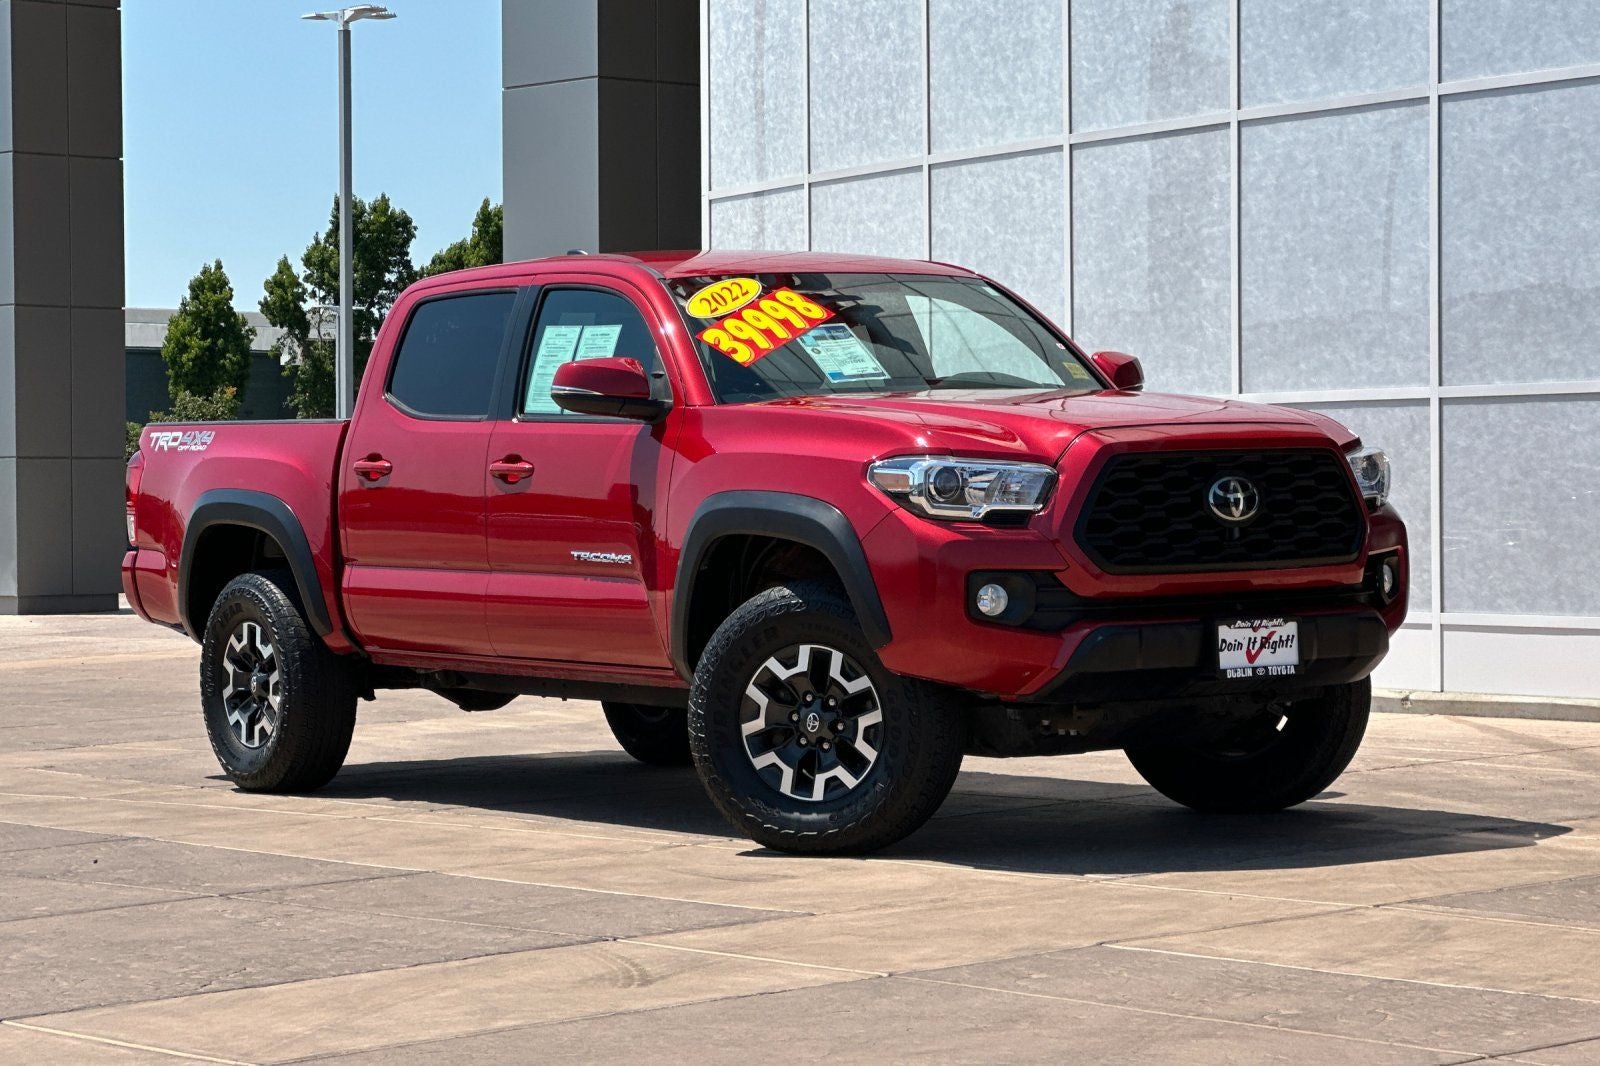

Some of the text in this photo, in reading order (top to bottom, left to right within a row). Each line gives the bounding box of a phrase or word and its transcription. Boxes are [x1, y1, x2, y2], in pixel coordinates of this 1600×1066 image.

[699, 281, 749, 315] 2022
[702, 290, 827, 363] 39998
[149, 431, 183, 451] TRD
[570, 551, 632, 564] TACOMA
[1219, 634, 1295, 654] Doin' It Right!
[1226, 665, 1296, 678] DUBLIN TOYOTA
